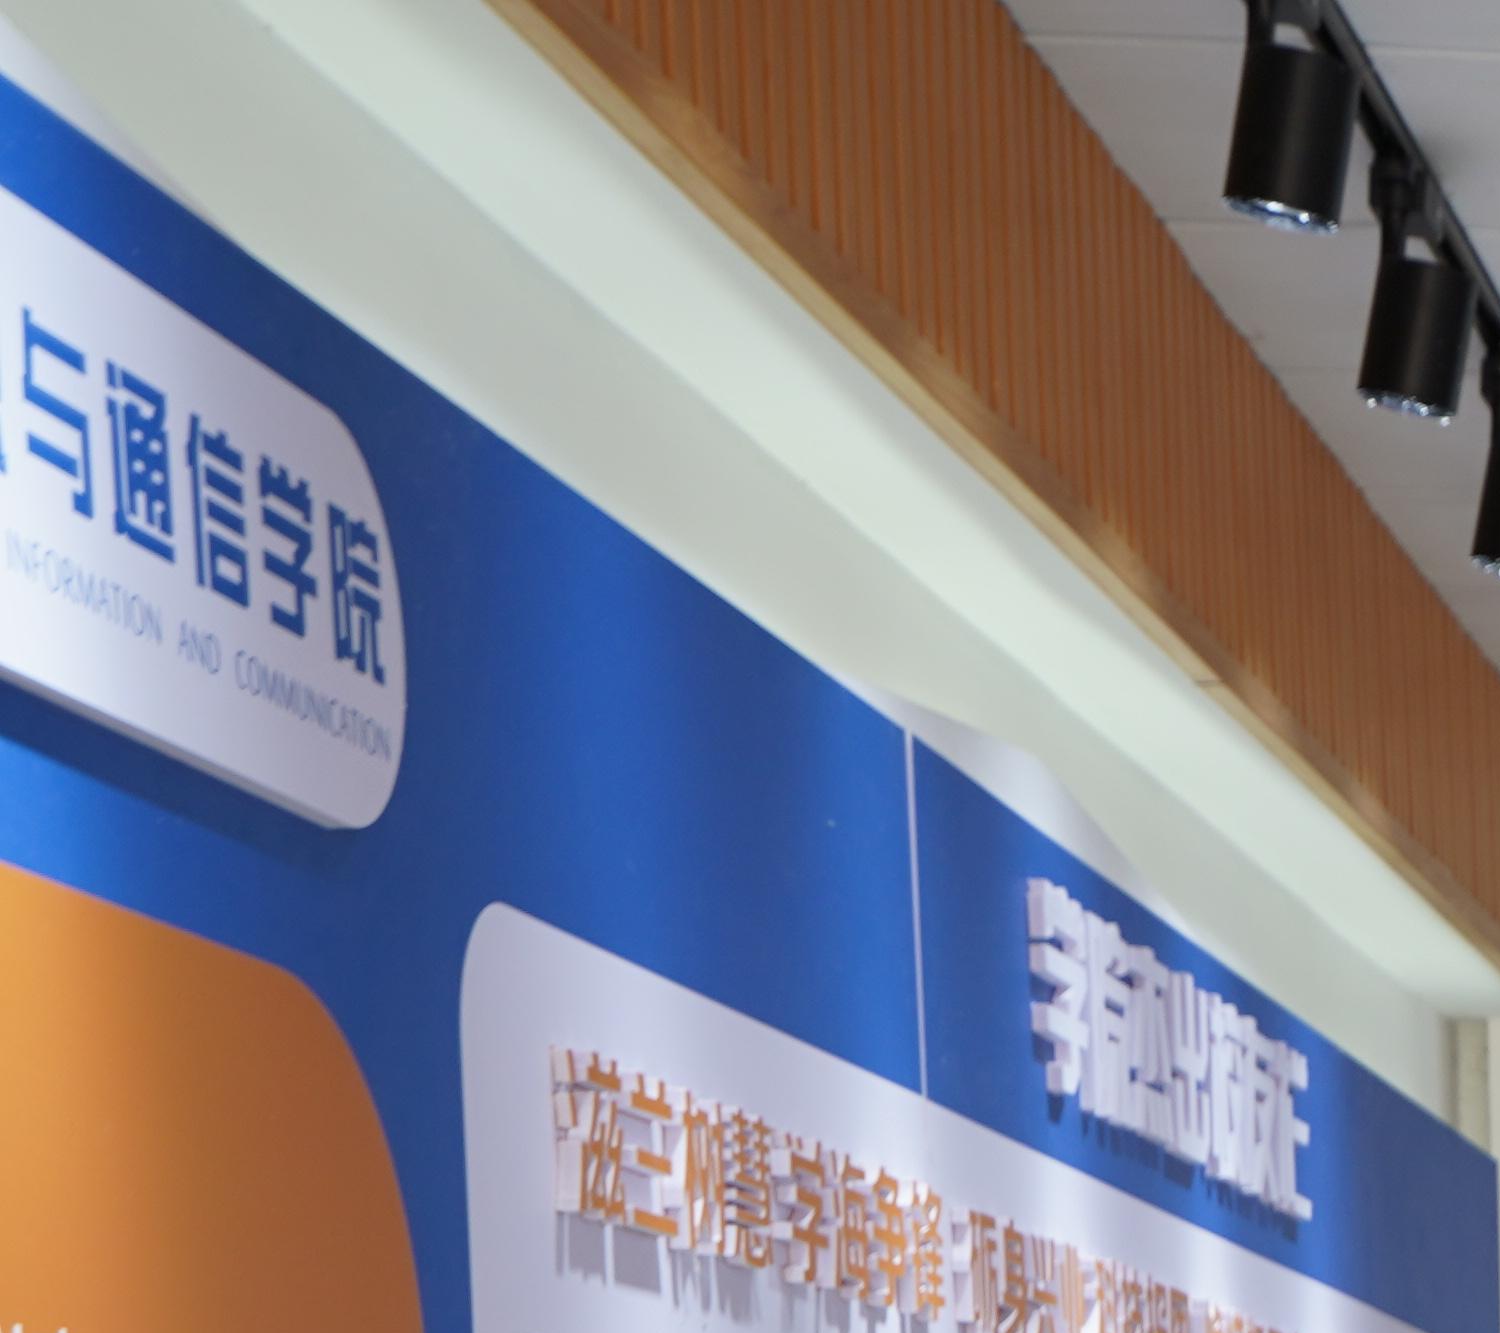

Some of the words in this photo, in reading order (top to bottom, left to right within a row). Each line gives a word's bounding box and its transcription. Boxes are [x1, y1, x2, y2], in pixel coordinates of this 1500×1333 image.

[0, 306, 387, 687] 与通信学院
[4, 527, 164, 645] INFORMATION
[177, 618, 222, 675] AND
[233, 648, 393, 763] COMMUNICATION
